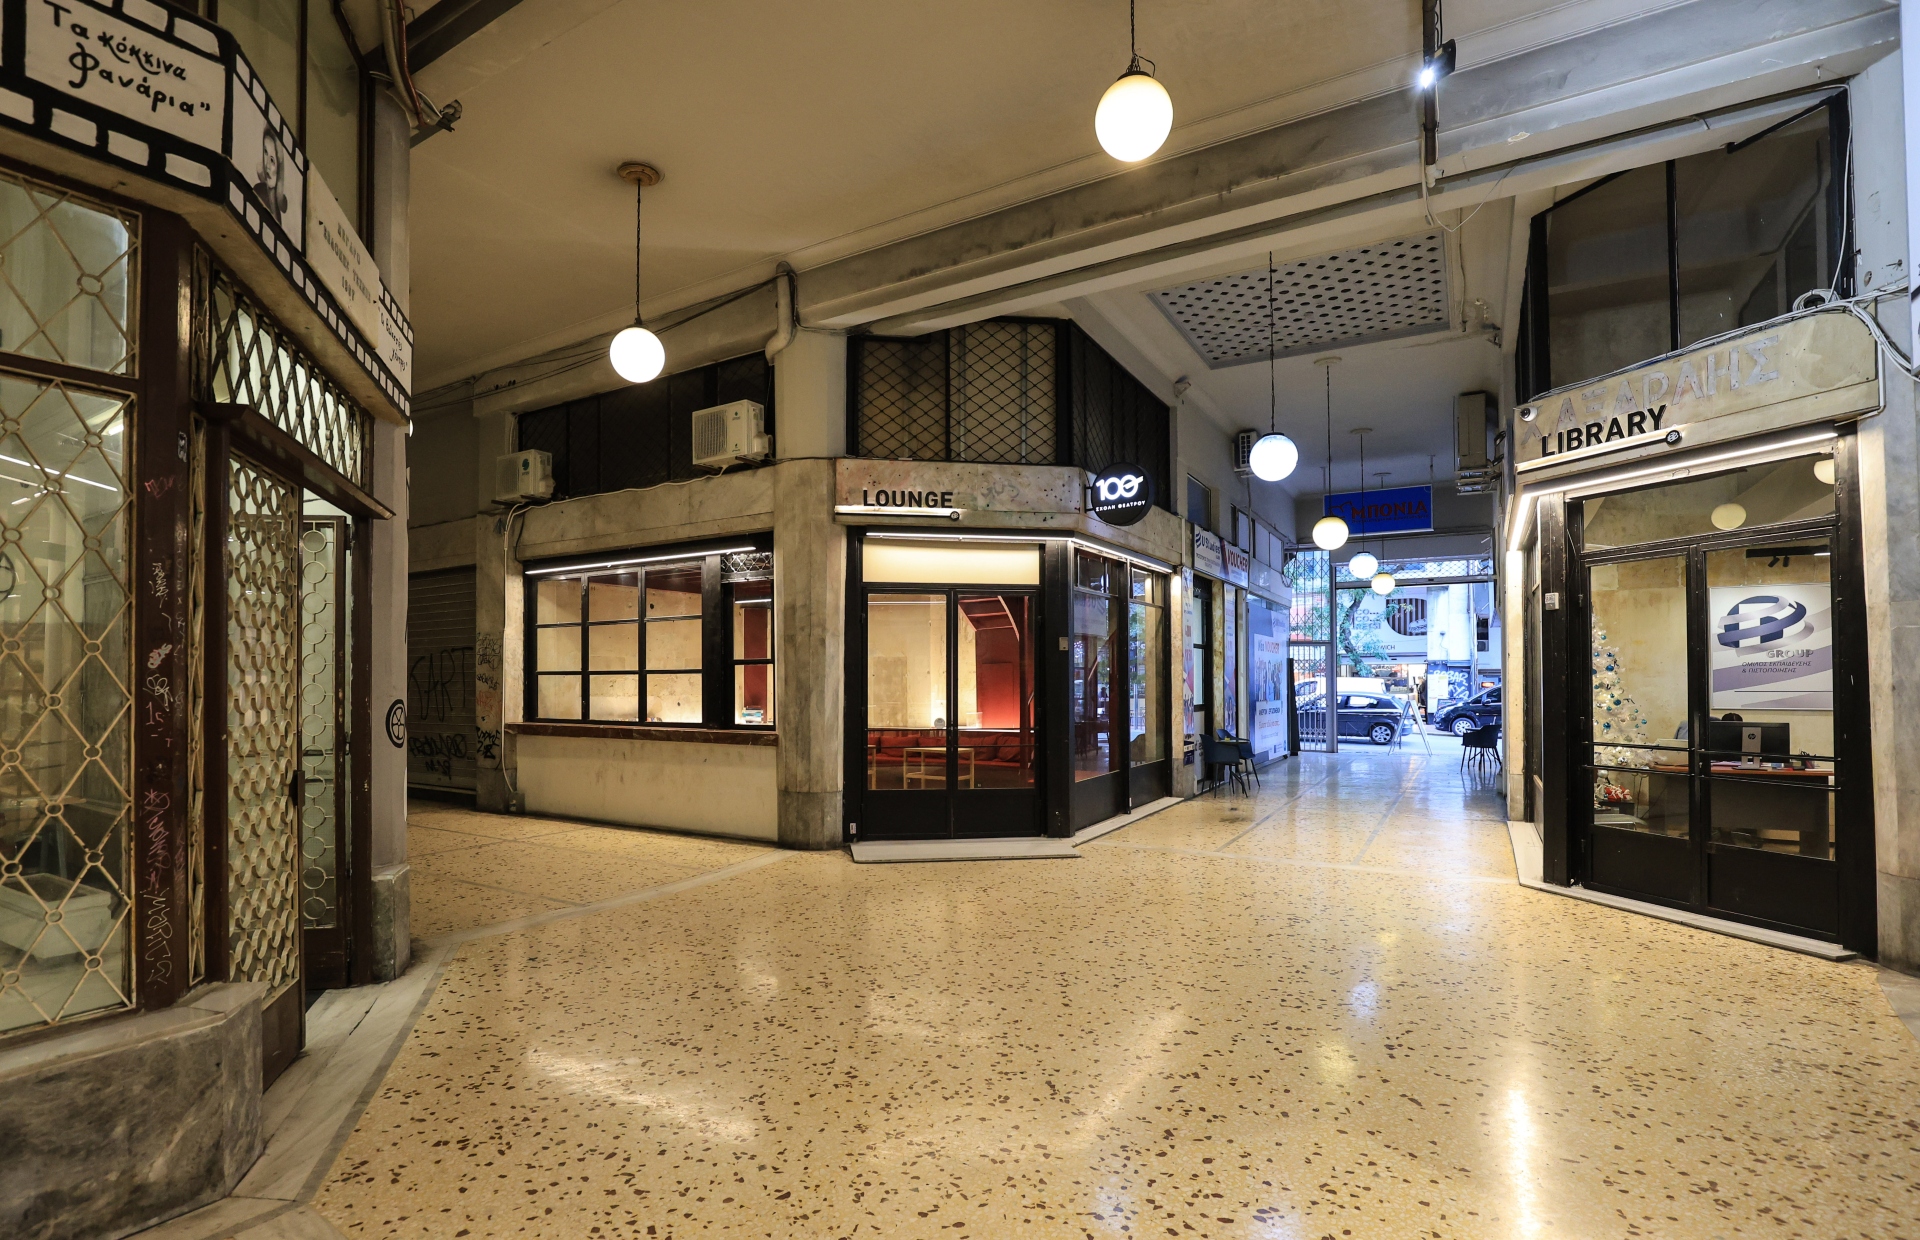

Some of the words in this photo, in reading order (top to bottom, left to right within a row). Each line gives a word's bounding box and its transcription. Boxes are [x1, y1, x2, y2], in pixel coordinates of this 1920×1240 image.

[1541, 404, 1667, 458] LIBRARY
[863, 489, 954, 509] LOUNGE
[1095, 504, 1116, 512] ΣΧΟΛΗ
[1117, 500, 1146, 509] ΘΕΑΤΡΟΥ
[1227, 548, 1248, 574] VOUCHER
[1767, 649, 1814, 658] GROUP
